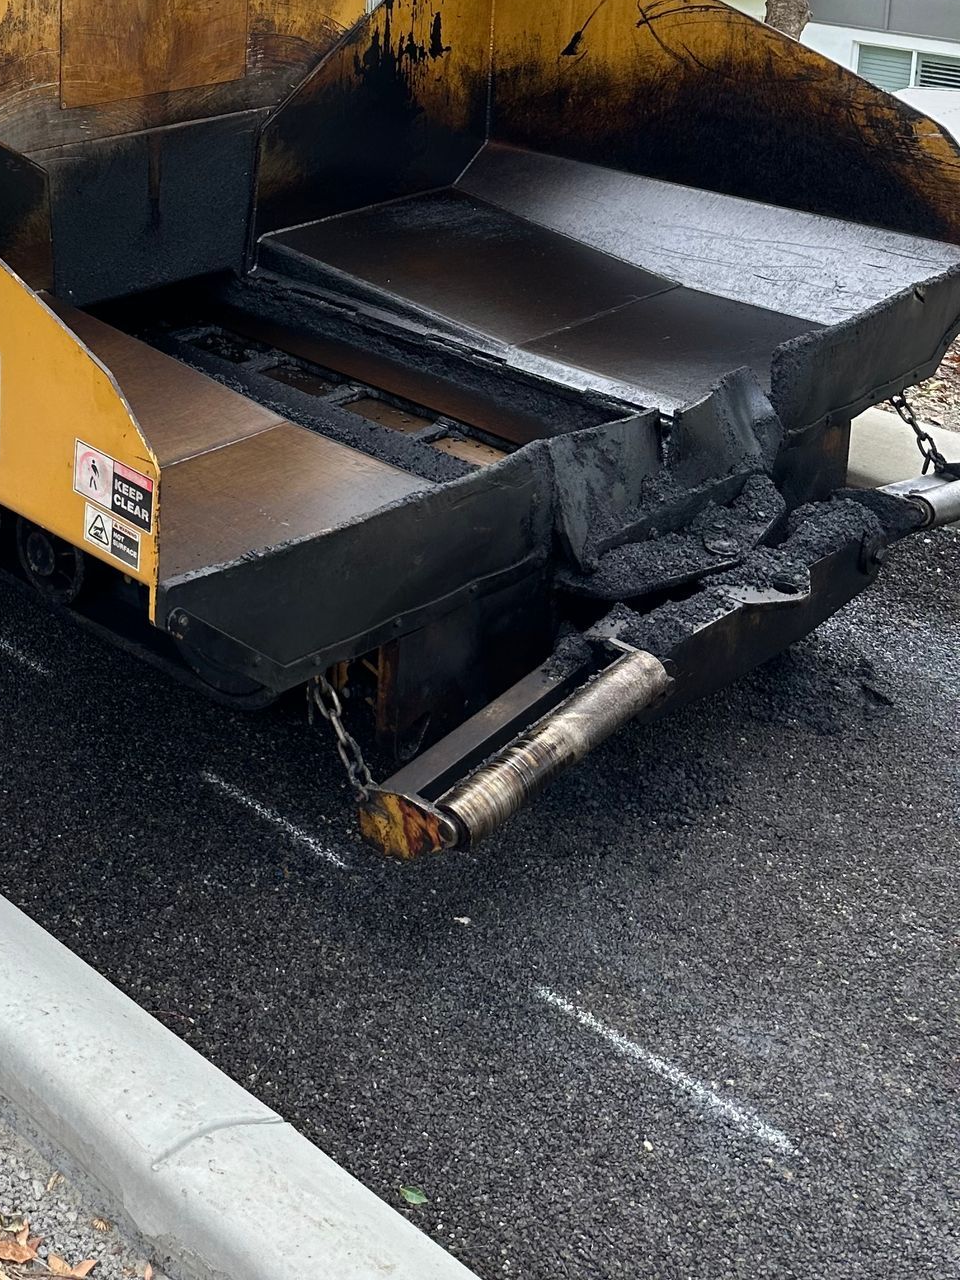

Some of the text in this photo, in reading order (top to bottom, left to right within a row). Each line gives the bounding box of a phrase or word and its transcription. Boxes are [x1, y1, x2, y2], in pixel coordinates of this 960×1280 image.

[114, 478, 144, 502] KEEP
[113, 493, 150, 523] CLEAR
[112, 539, 138, 560] SURFACE
